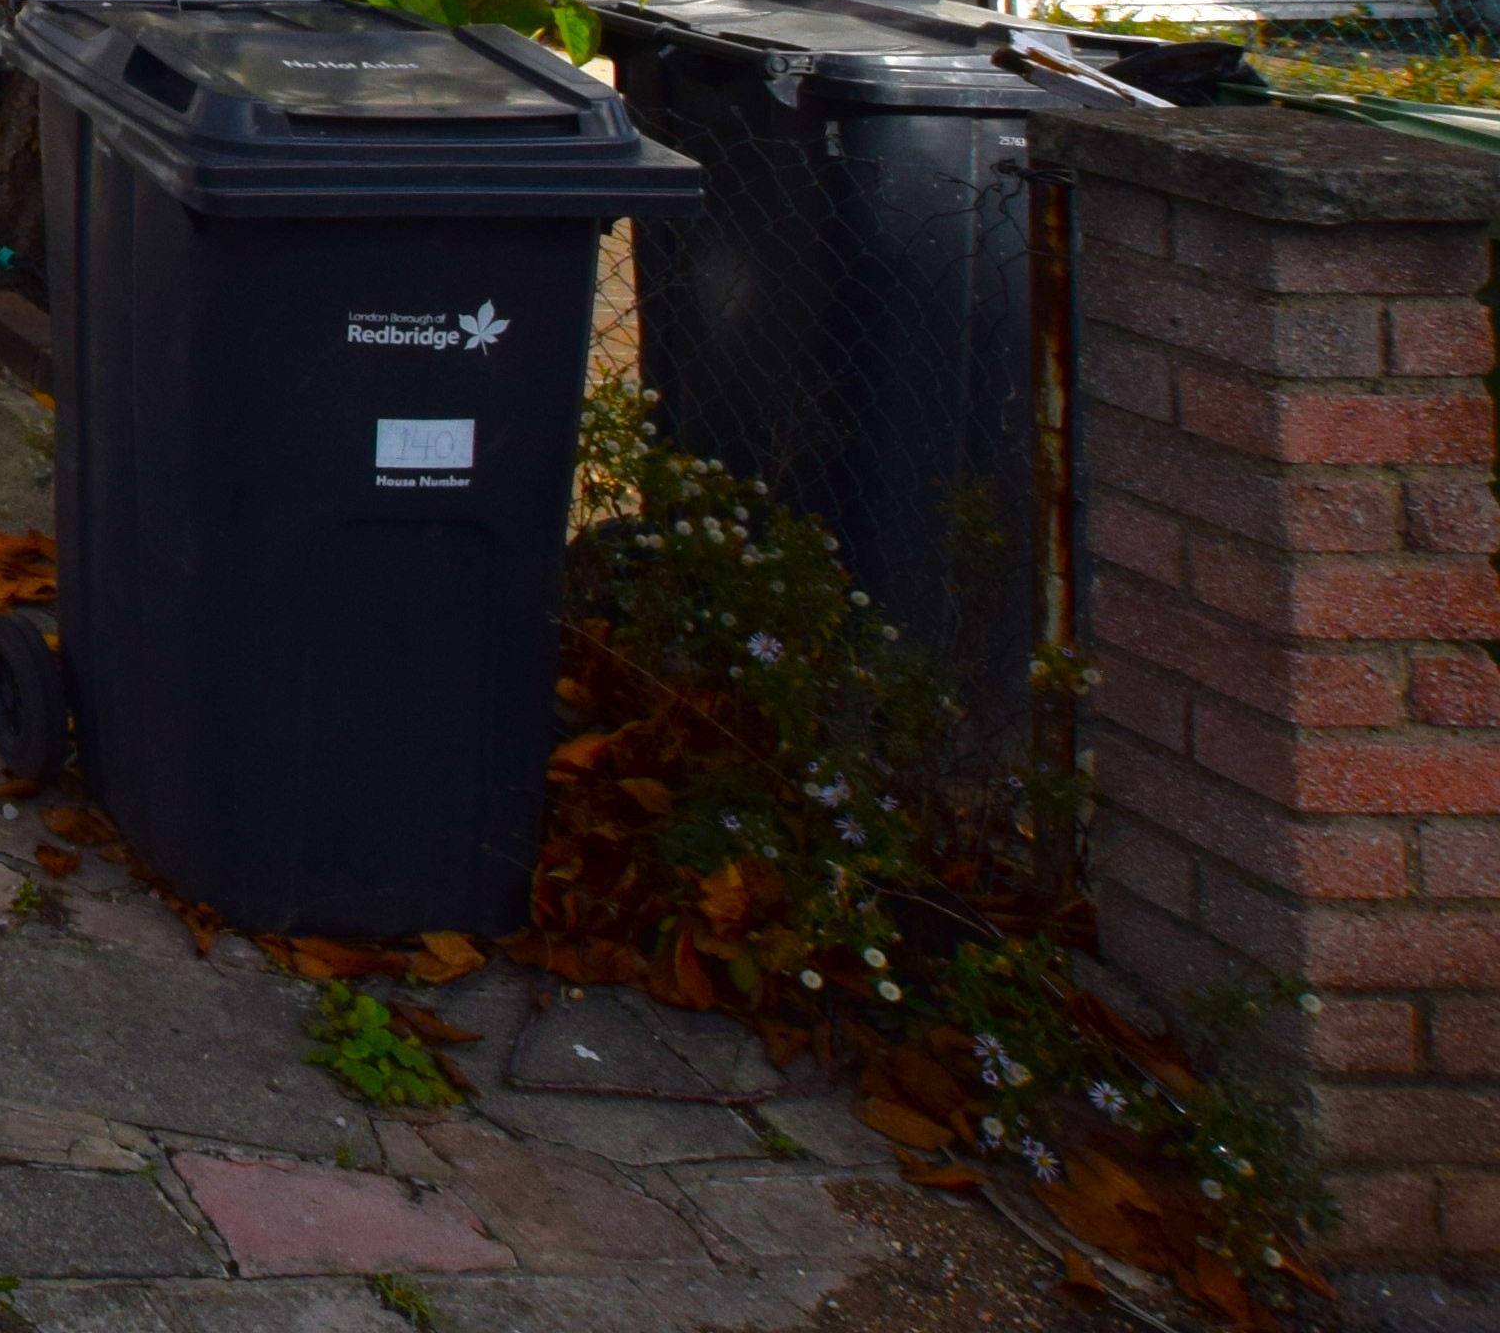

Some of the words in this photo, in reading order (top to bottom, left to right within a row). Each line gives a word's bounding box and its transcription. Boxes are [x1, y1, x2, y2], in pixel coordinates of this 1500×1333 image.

[281, 59, 317, 70] No
[318, 59, 358, 70] Hot
[360, 60, 420, 70] Ashes
[348, 311, 388, 322] London
[390, 312, 434, 326] Borough
[434, 313, 446, 324] of
[347, 324, 460, 350] Redbridge
[395, 426, 455, 462] 140
[375, 474, 417, 488] House
[419, 474, 471, 488] Number
